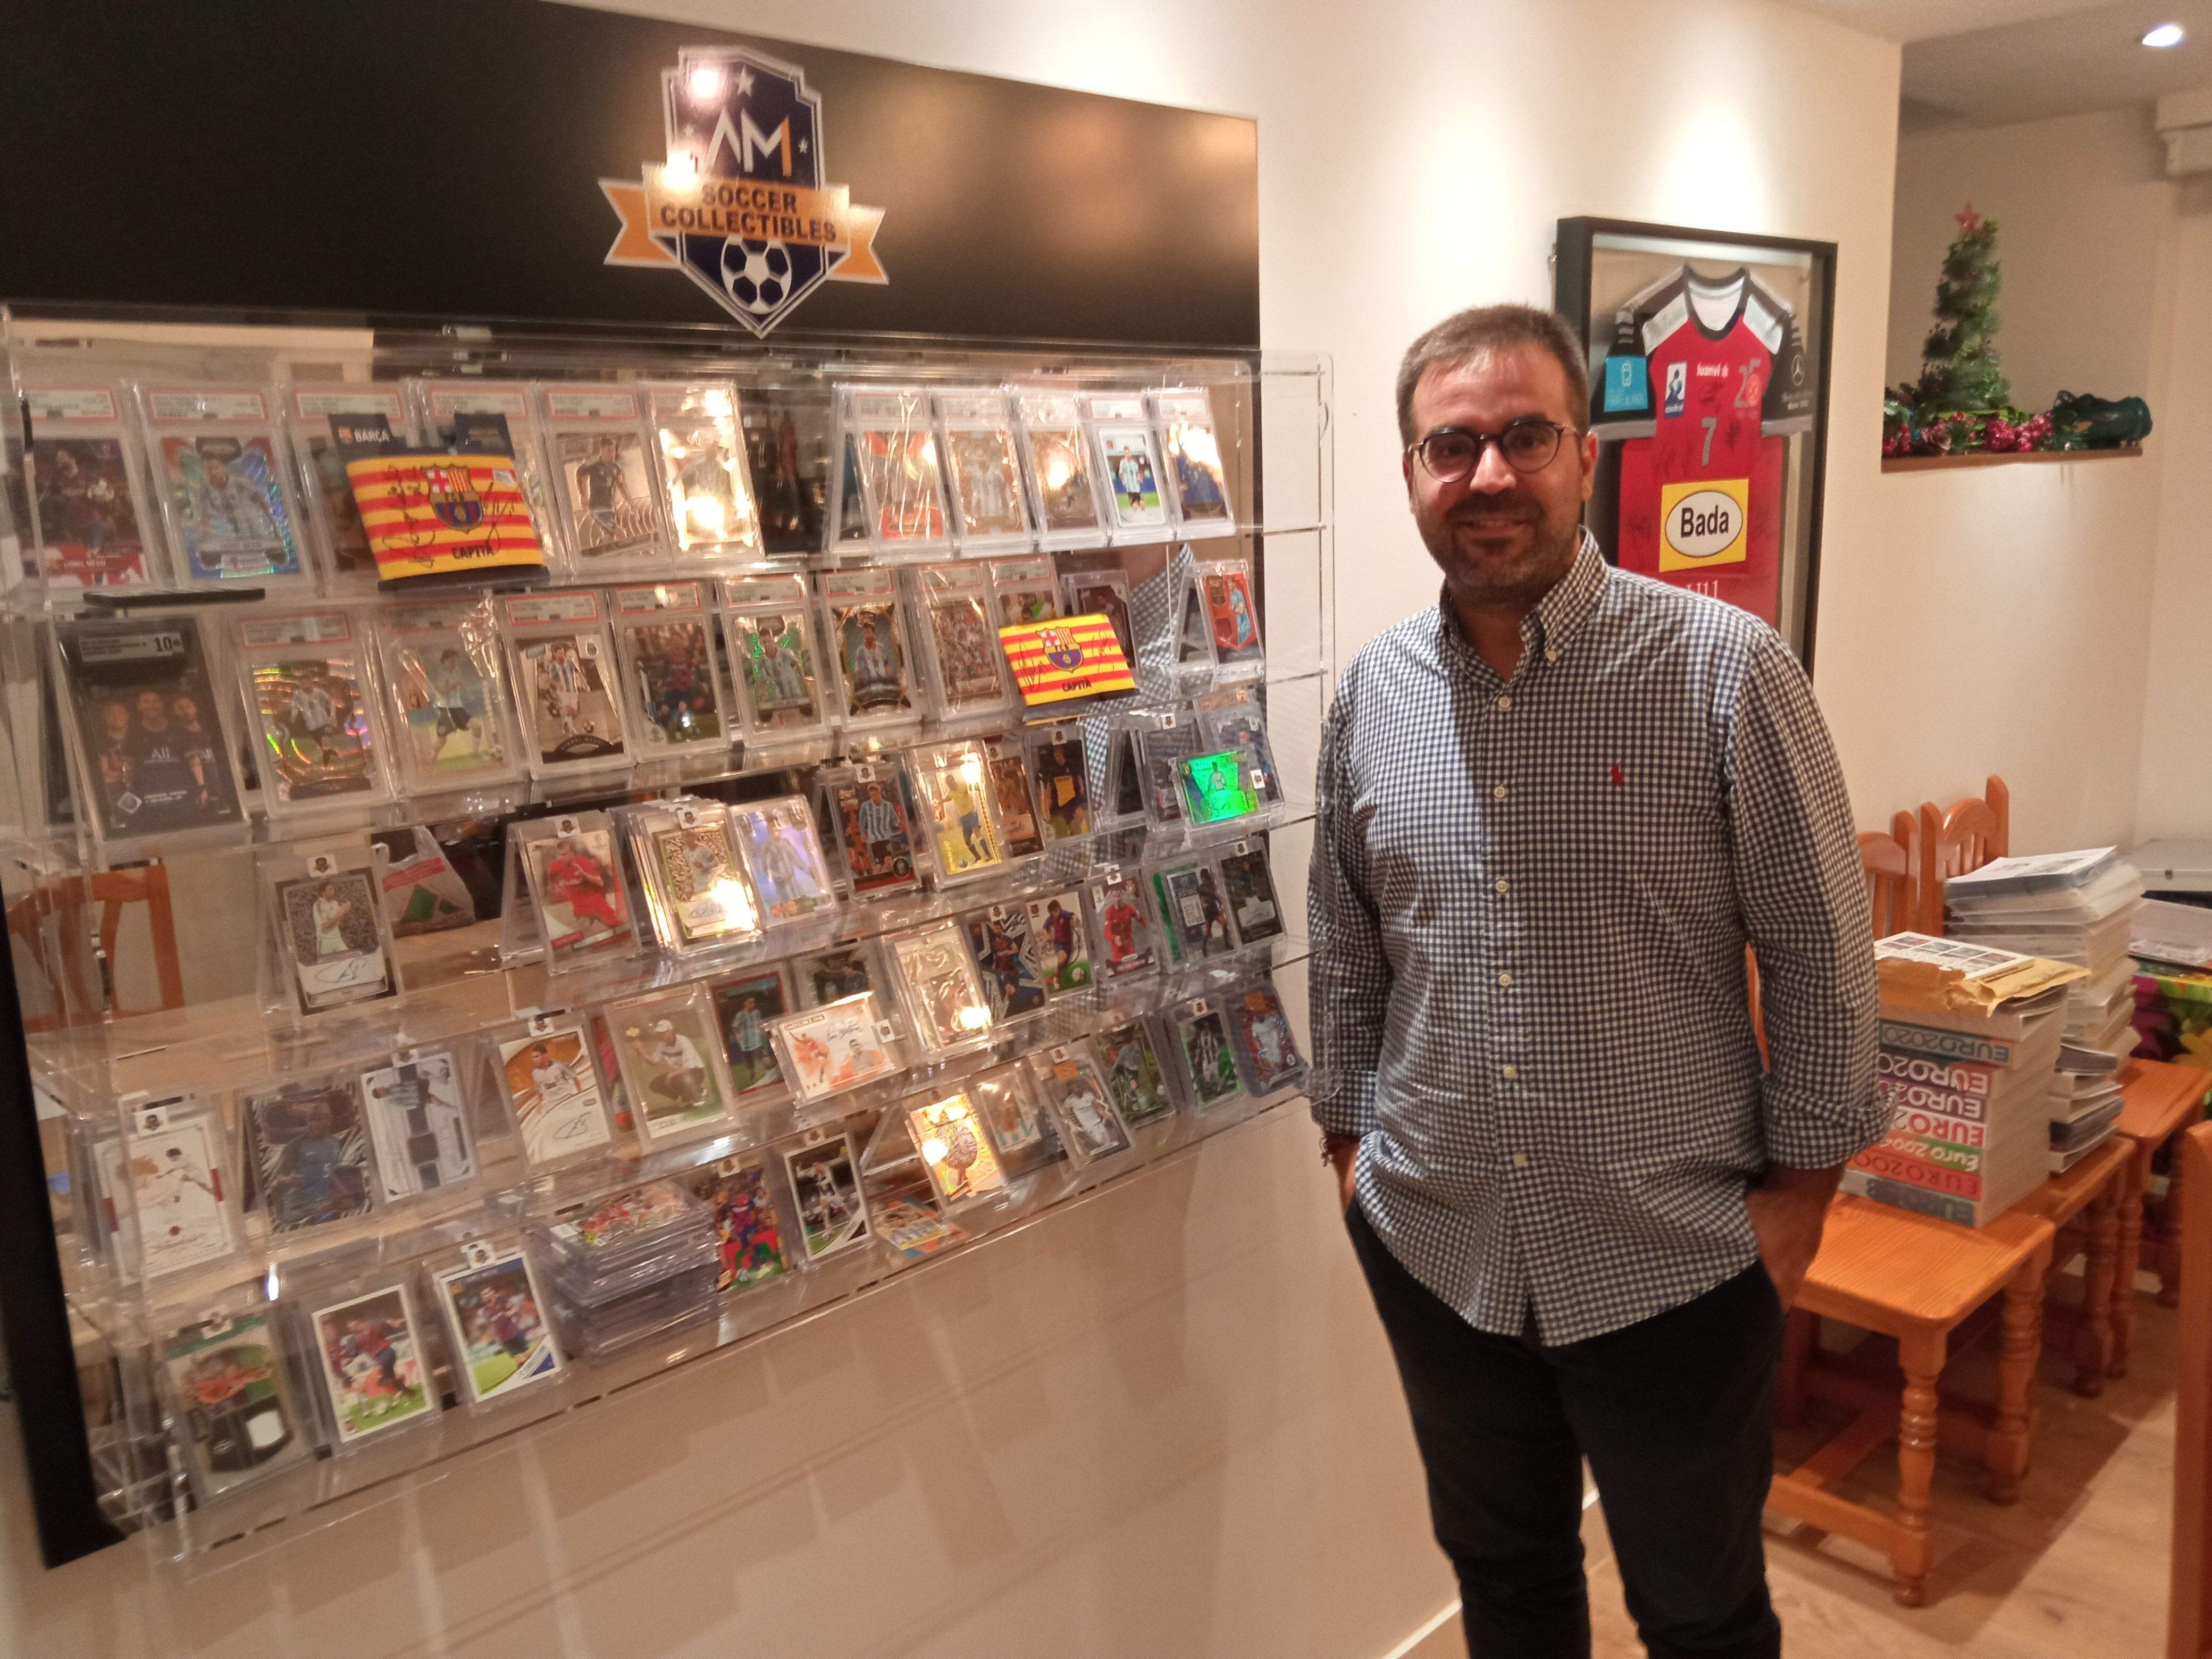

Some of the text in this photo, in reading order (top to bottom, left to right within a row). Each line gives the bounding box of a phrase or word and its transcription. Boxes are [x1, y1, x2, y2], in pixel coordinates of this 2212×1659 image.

[702, 183, 797, 214] SOCCER
[660, 206, 837, 242] COLLECTIBLES
[354, 428, 390, 443] BARÇA
[1702, 417, 1716, 466] 7
[1680, 505, 1729, 538] Bada
[154, 636, 172, 652] 10
[1884, 1027, 2010, 1063] EURO2020
[1930, 1147, 1979, 1172] Euro
